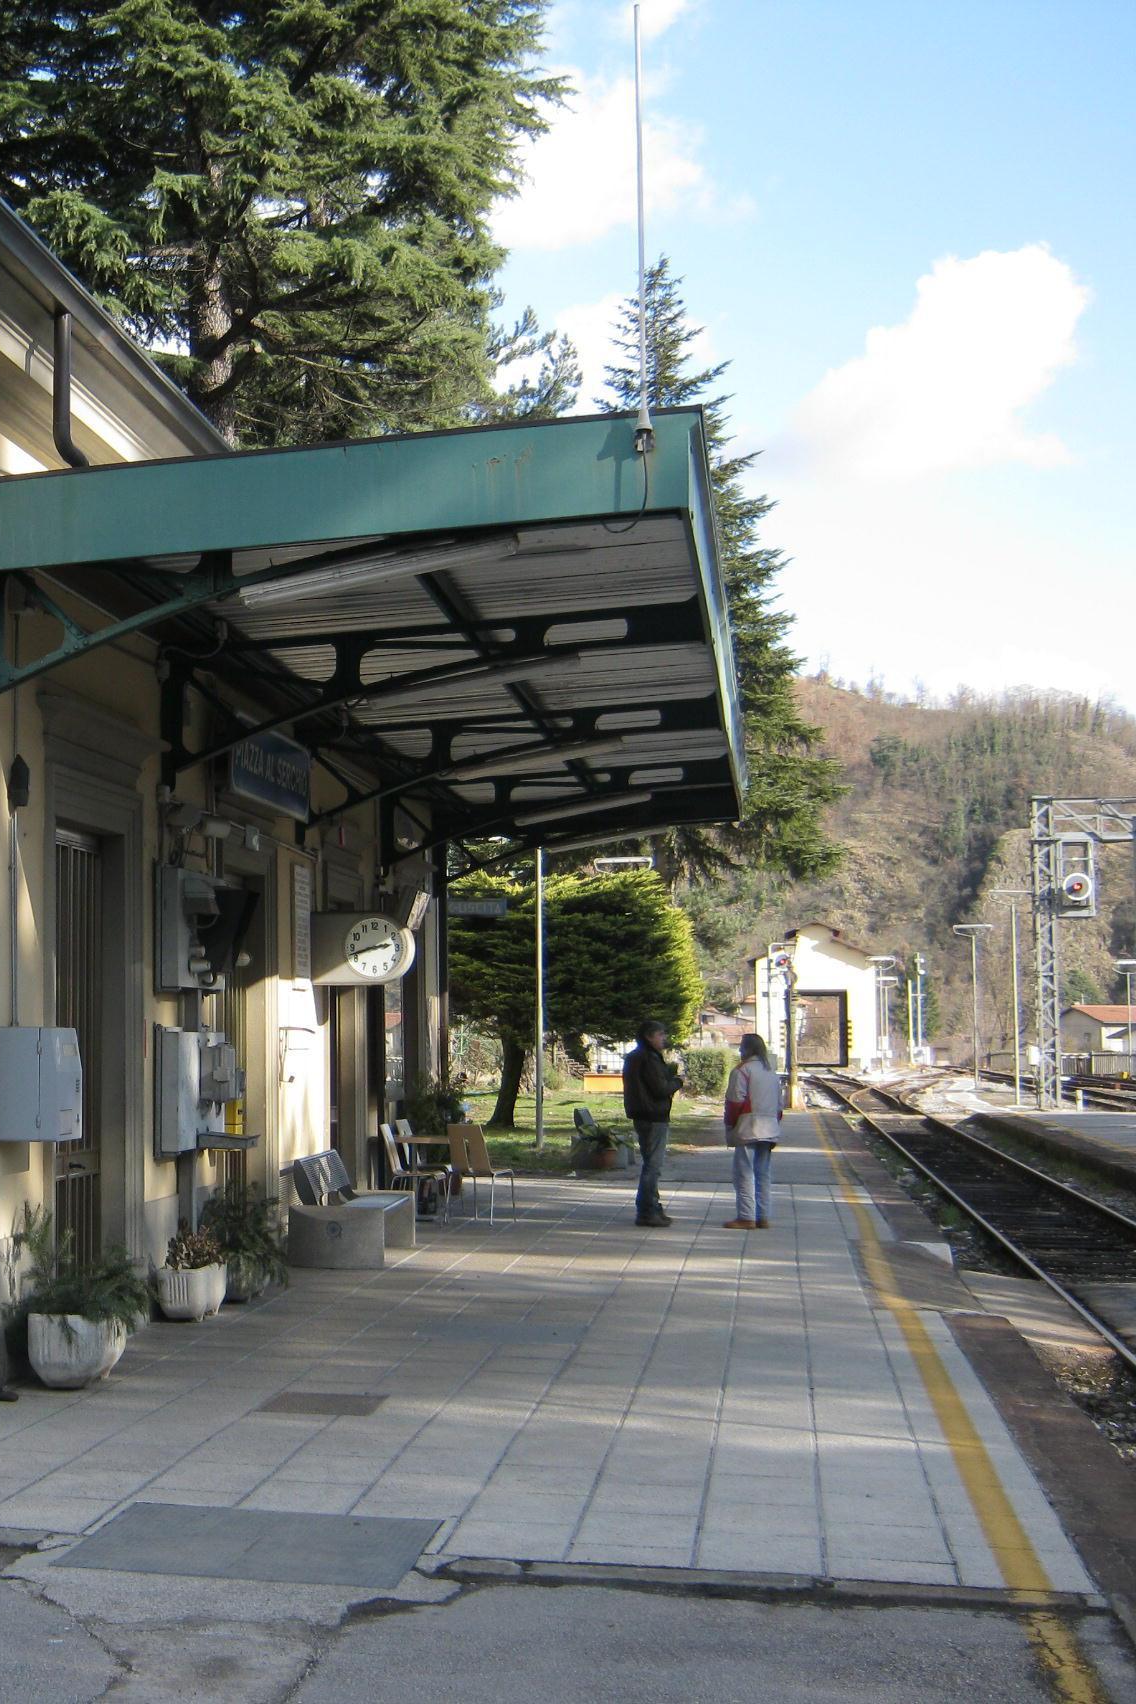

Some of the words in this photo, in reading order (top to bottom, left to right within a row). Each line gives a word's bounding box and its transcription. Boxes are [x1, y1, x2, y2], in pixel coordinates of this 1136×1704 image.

[235, 742, 264, 777] PIAZZA
[265, 752, 275, 782] AL
[276, 757, 307, 797] SERCHIO
[362, 925, 368, 933] 11
[371, 922, 379, 930] 12
[353, 932, 360, 941] 10
[391, 932, 396, 940] 2
[350, 944, 355, 952] 9
[395, 944, 400, 952] 3
